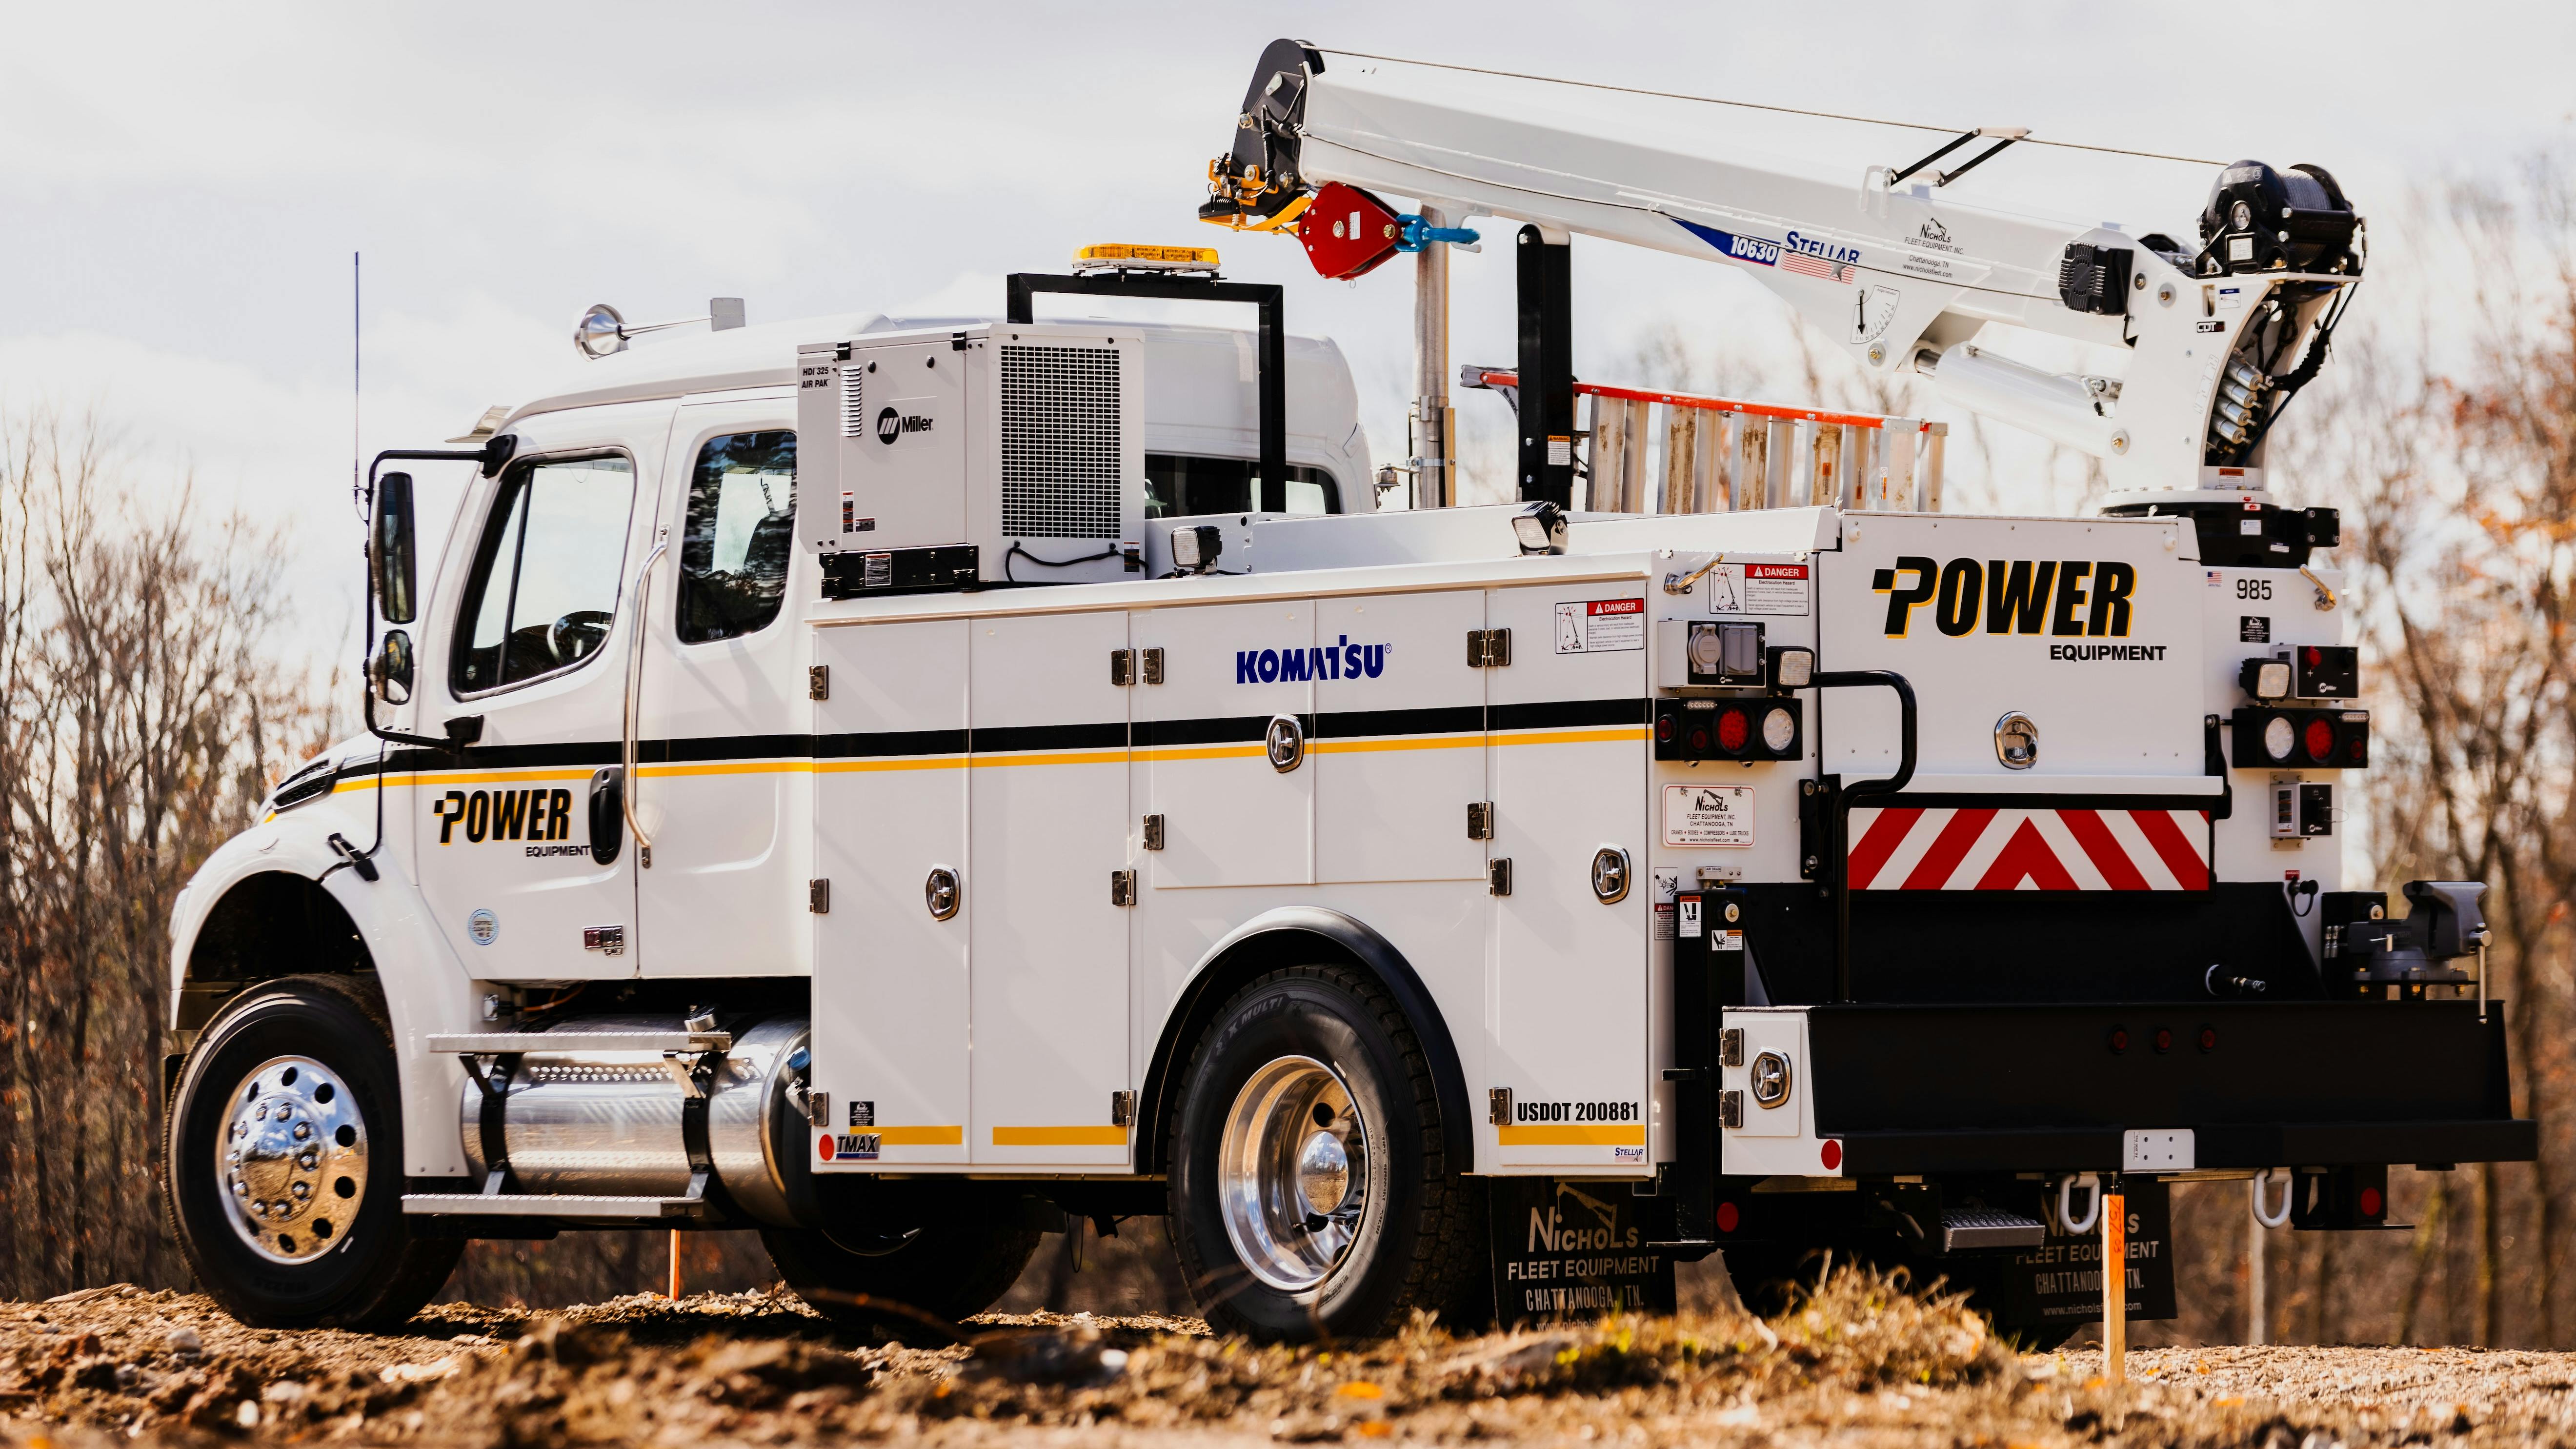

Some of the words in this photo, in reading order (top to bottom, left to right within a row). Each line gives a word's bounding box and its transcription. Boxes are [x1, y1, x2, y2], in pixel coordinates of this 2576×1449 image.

[1731, 236, 1777, 262] 10630
[1905, 237, 1921, 245] FLEET
[1903, 263, 1952, 278] www.nicholsfleet.com
[2197, 322, 2216, 332] CDT
[802, 380, 813, 389] AIR
[902, 415, 933, 433] Miller
[1765, 567, 1799, 577] DANGER
[1872, 556, 2137, 640] POWER
[2237, 579, 2272, 600] 985
[1605, 603, 1635, 612] DANGER
[1237, 635, 1384, 684] KOMATSU
[2050, 644, 2167, 663] EQUIPMENT
[433, 788, 572, 846] POWER
[526, 845, 591, 857] EQUIPMENT
[1242, 997, 1283, 1025] MULTI
[1518, 1103, 1571, 1121] USDOT
[1575, 1102, 1638, 1121] 200881
[837, 1136, 878, 1152] TMAX
[1615, 1147, 1643, 1156] STELLAR
[1508, 1260, 1560, 1281] FLEET
[1565, 1255, 1660, 1277] EQUIPMENT
[2126, 1268, 2145, 1289] TN.
[1625, 1285, 1644, 1307] TN.
